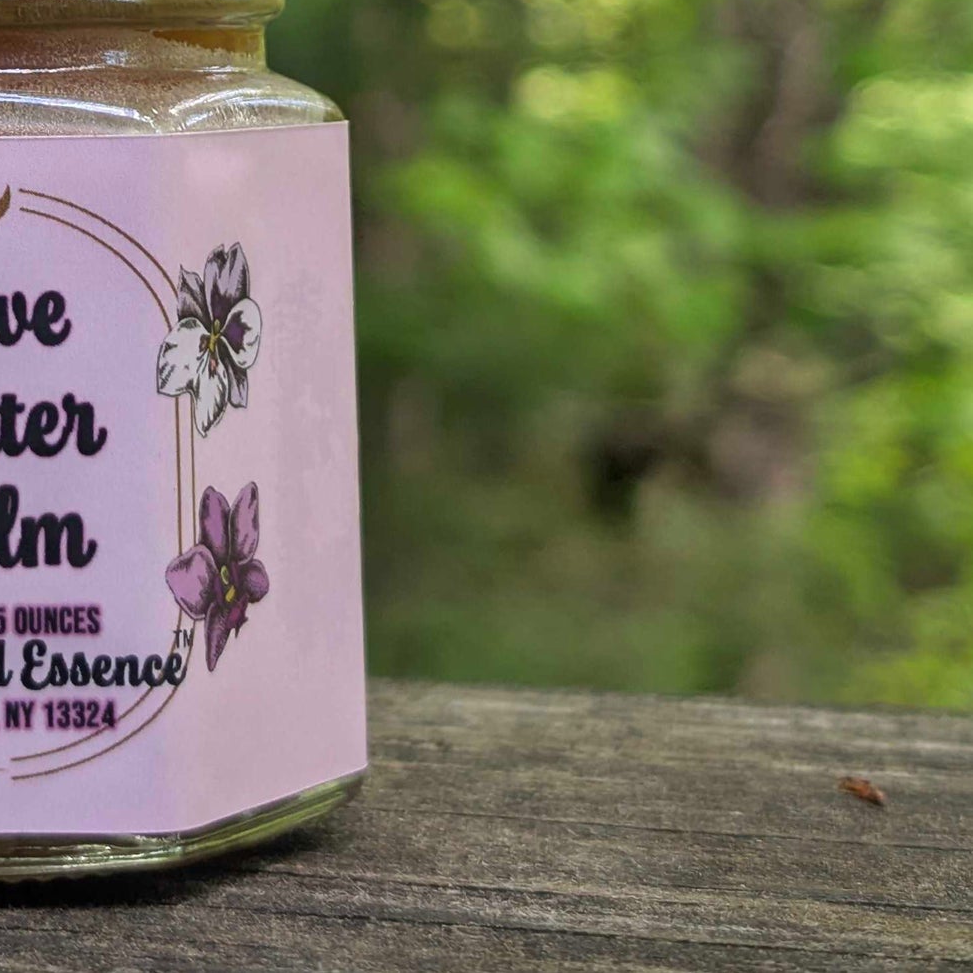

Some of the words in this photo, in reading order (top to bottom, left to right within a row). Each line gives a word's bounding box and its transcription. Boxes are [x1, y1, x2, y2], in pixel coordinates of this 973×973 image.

[13, 605, 102, 635] OUNCES
[5, 700, 35, 729] NY
[43, 700, 117, 729] 13324
